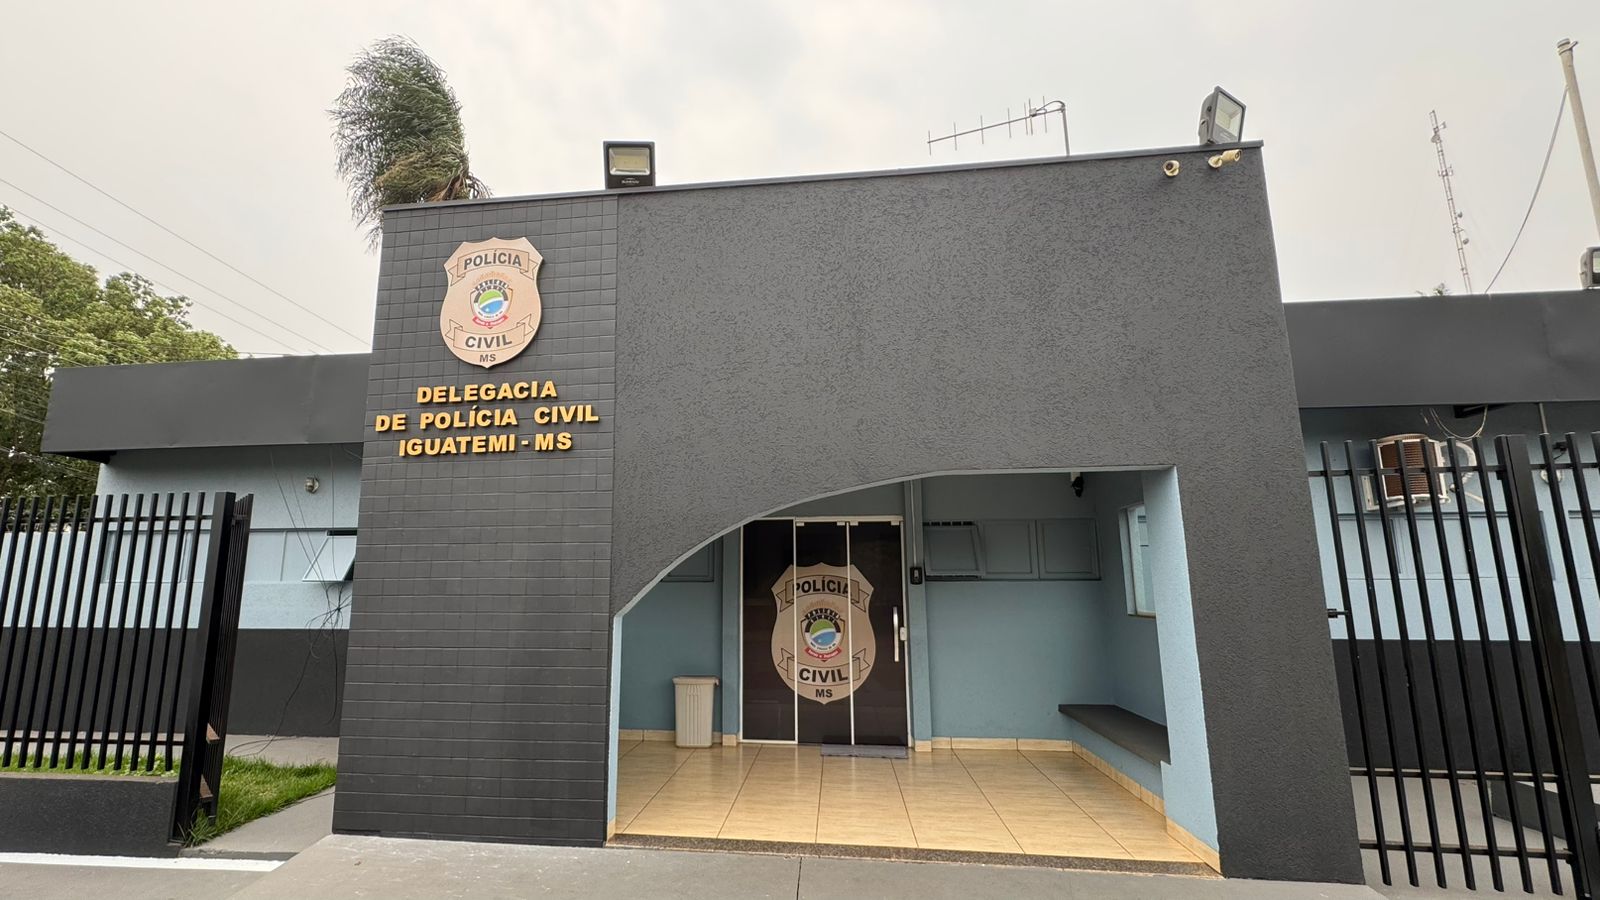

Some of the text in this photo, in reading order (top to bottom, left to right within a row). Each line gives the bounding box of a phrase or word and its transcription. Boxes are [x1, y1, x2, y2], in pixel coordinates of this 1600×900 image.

[463, 249, 522, 270] POLÍCIA
[465, 334, 512, 349] CIVIL
[479, 353, 496, 363] MS
[417, 381, 558, 403] DELEGACIA
[375, 405, 599, 432] DE POLÍCIA CIVIL
[398, 433, 516, 457] IGUATEMI
[535, 432, 572, 451] MS
[799, 668, 849, 683] CIVIL
[815, 688, 833, 698] MS
